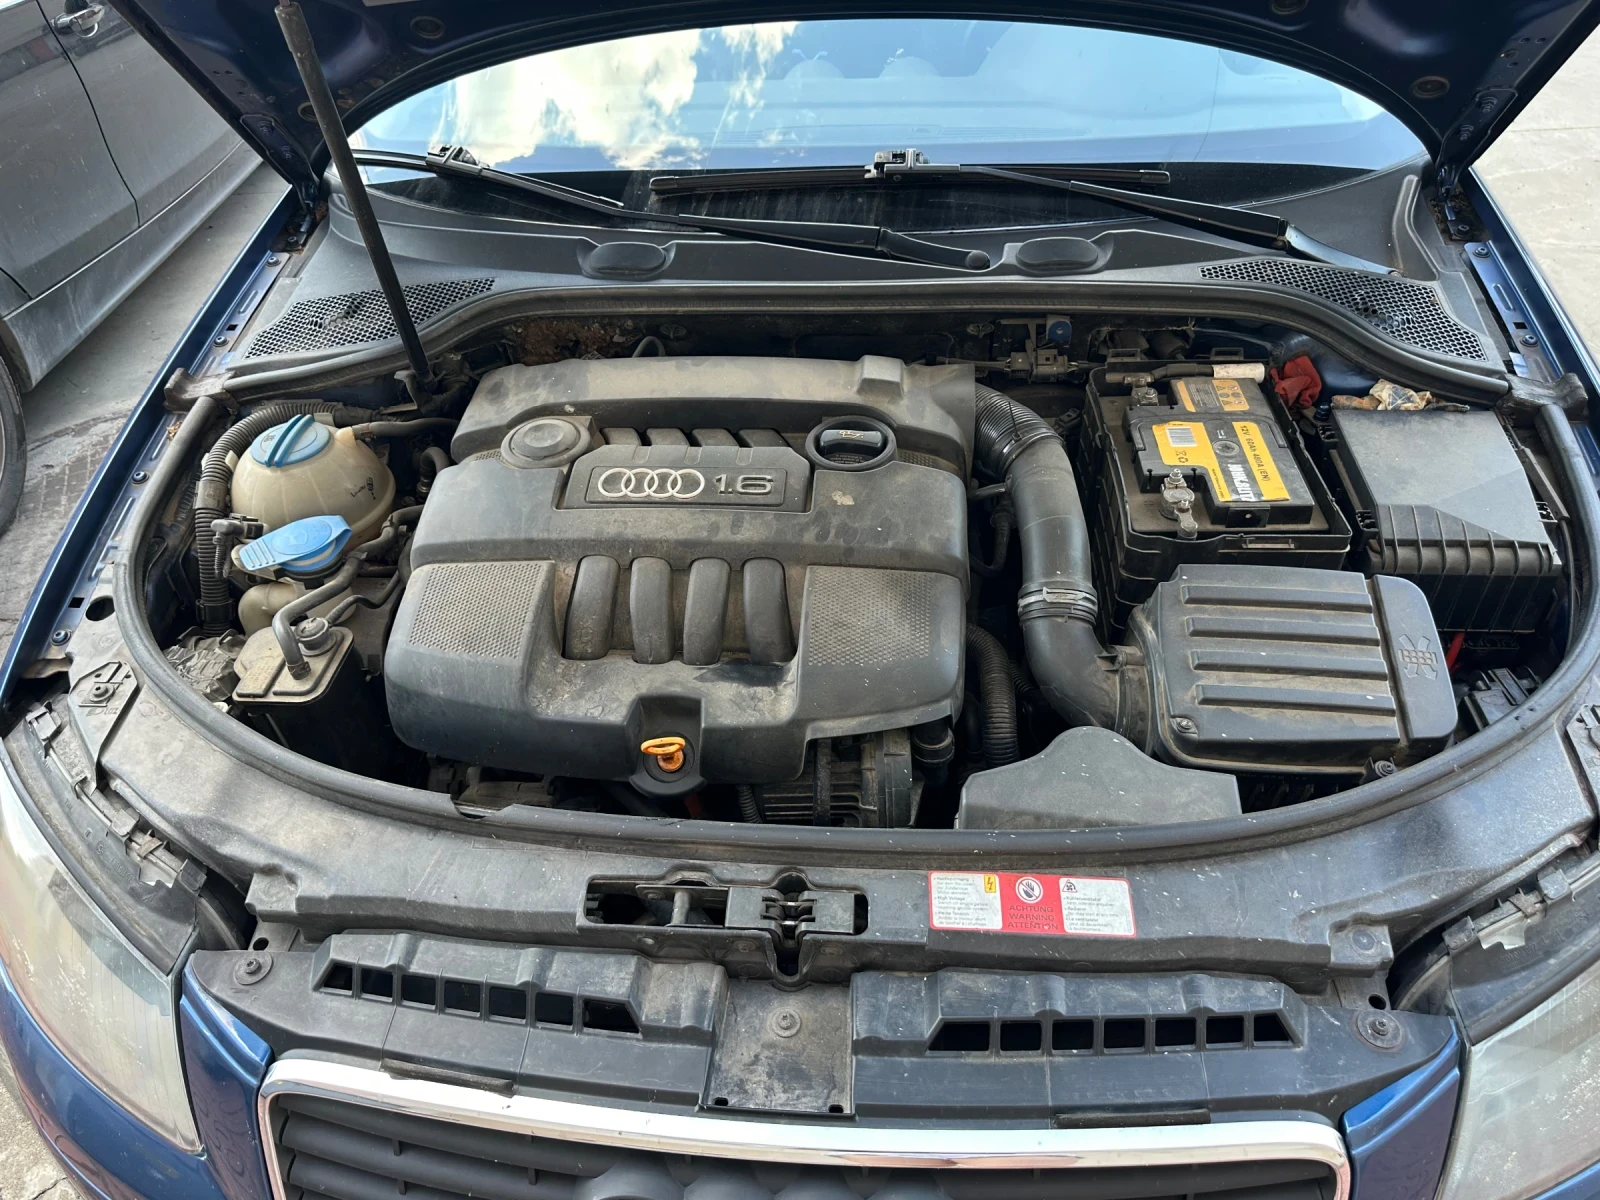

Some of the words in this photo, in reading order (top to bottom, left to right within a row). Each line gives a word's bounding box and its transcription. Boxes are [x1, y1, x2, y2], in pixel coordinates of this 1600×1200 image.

[1241, 425, 1251, 436] 12V
[715, 474, 774, 496] 1.6
[1009, 905, 1054, 913] ACHTUNG
[1009, 913, 1055, 921] WARNING
[1008, 921, 1059, 930] ATTENTION
